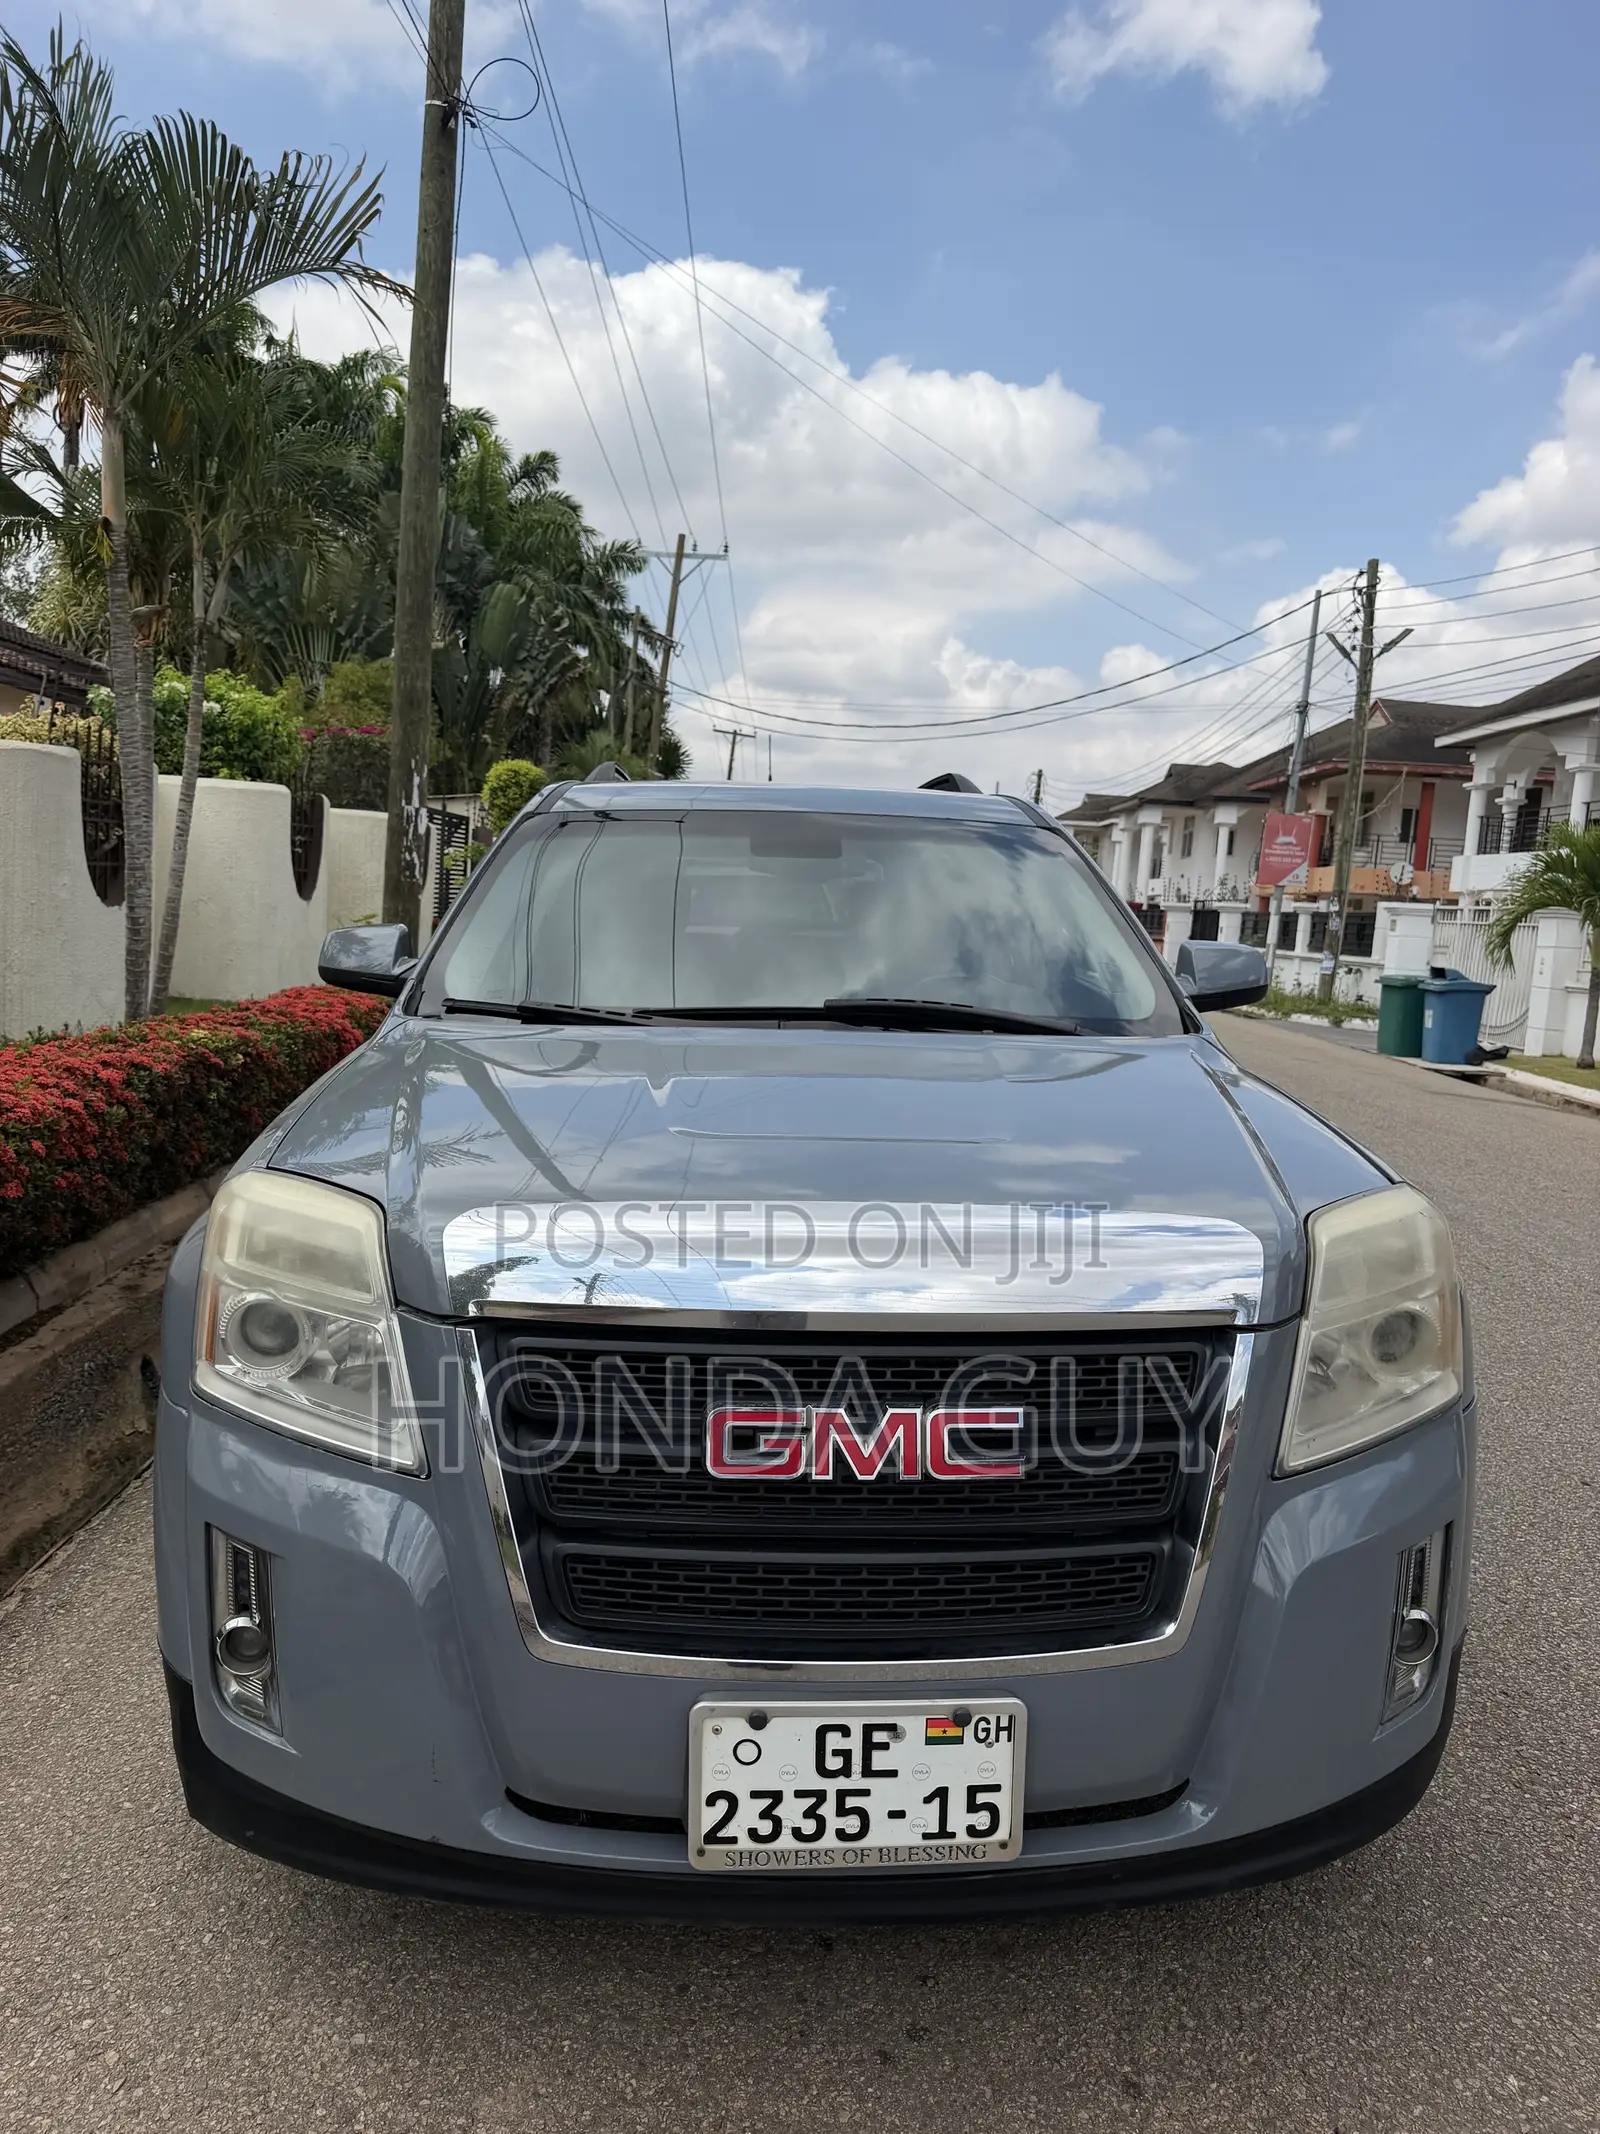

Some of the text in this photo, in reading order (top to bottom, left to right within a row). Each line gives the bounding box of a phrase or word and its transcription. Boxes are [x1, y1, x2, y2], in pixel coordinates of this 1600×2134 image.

[705, 1404, 1026, 1481] GMC
[815, 1723, 898, 1779] GE
[973, 1715, 1014, 1744] GH
[703, 1784, 1001, 1845] 2335-15
[724, 1844, 987, 1868] SHOWERS OF BLESSING
